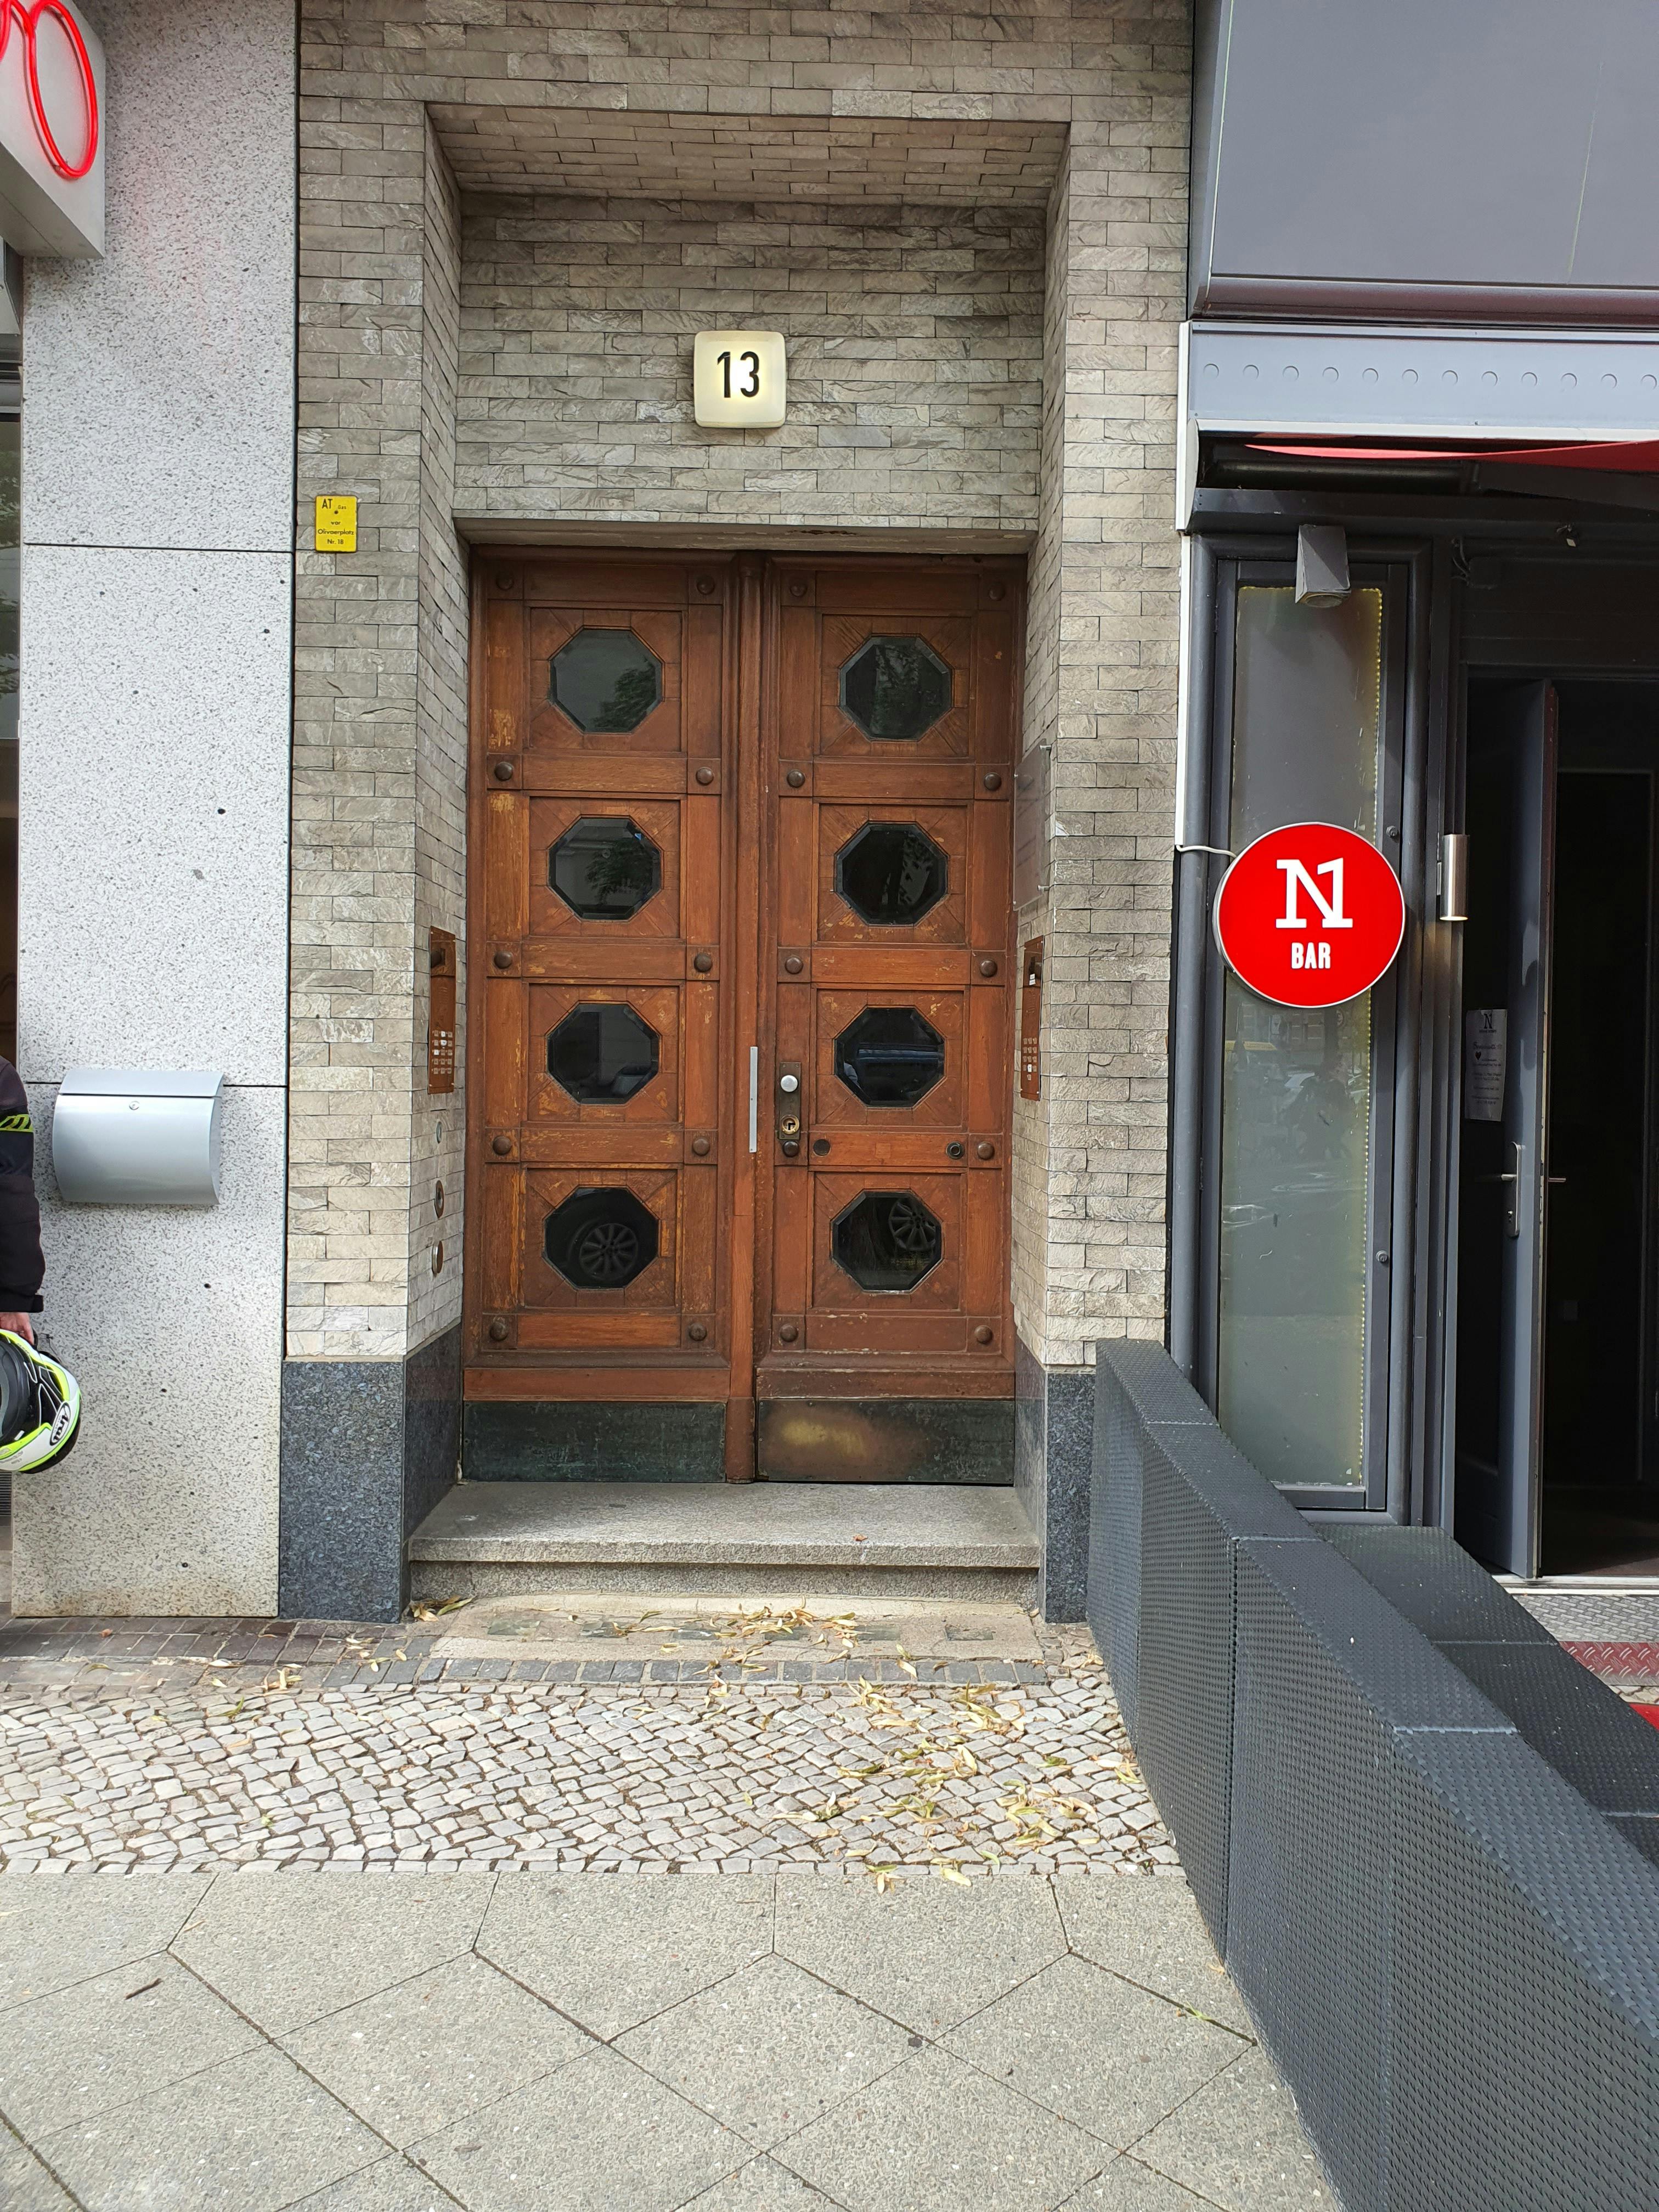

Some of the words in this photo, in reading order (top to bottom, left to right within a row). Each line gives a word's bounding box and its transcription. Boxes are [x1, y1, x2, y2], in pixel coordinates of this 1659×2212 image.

[717, 351, 759, 398] 13
[321, 498, 333, 509] AT
[1291, 942, 1331, 969] BAR
